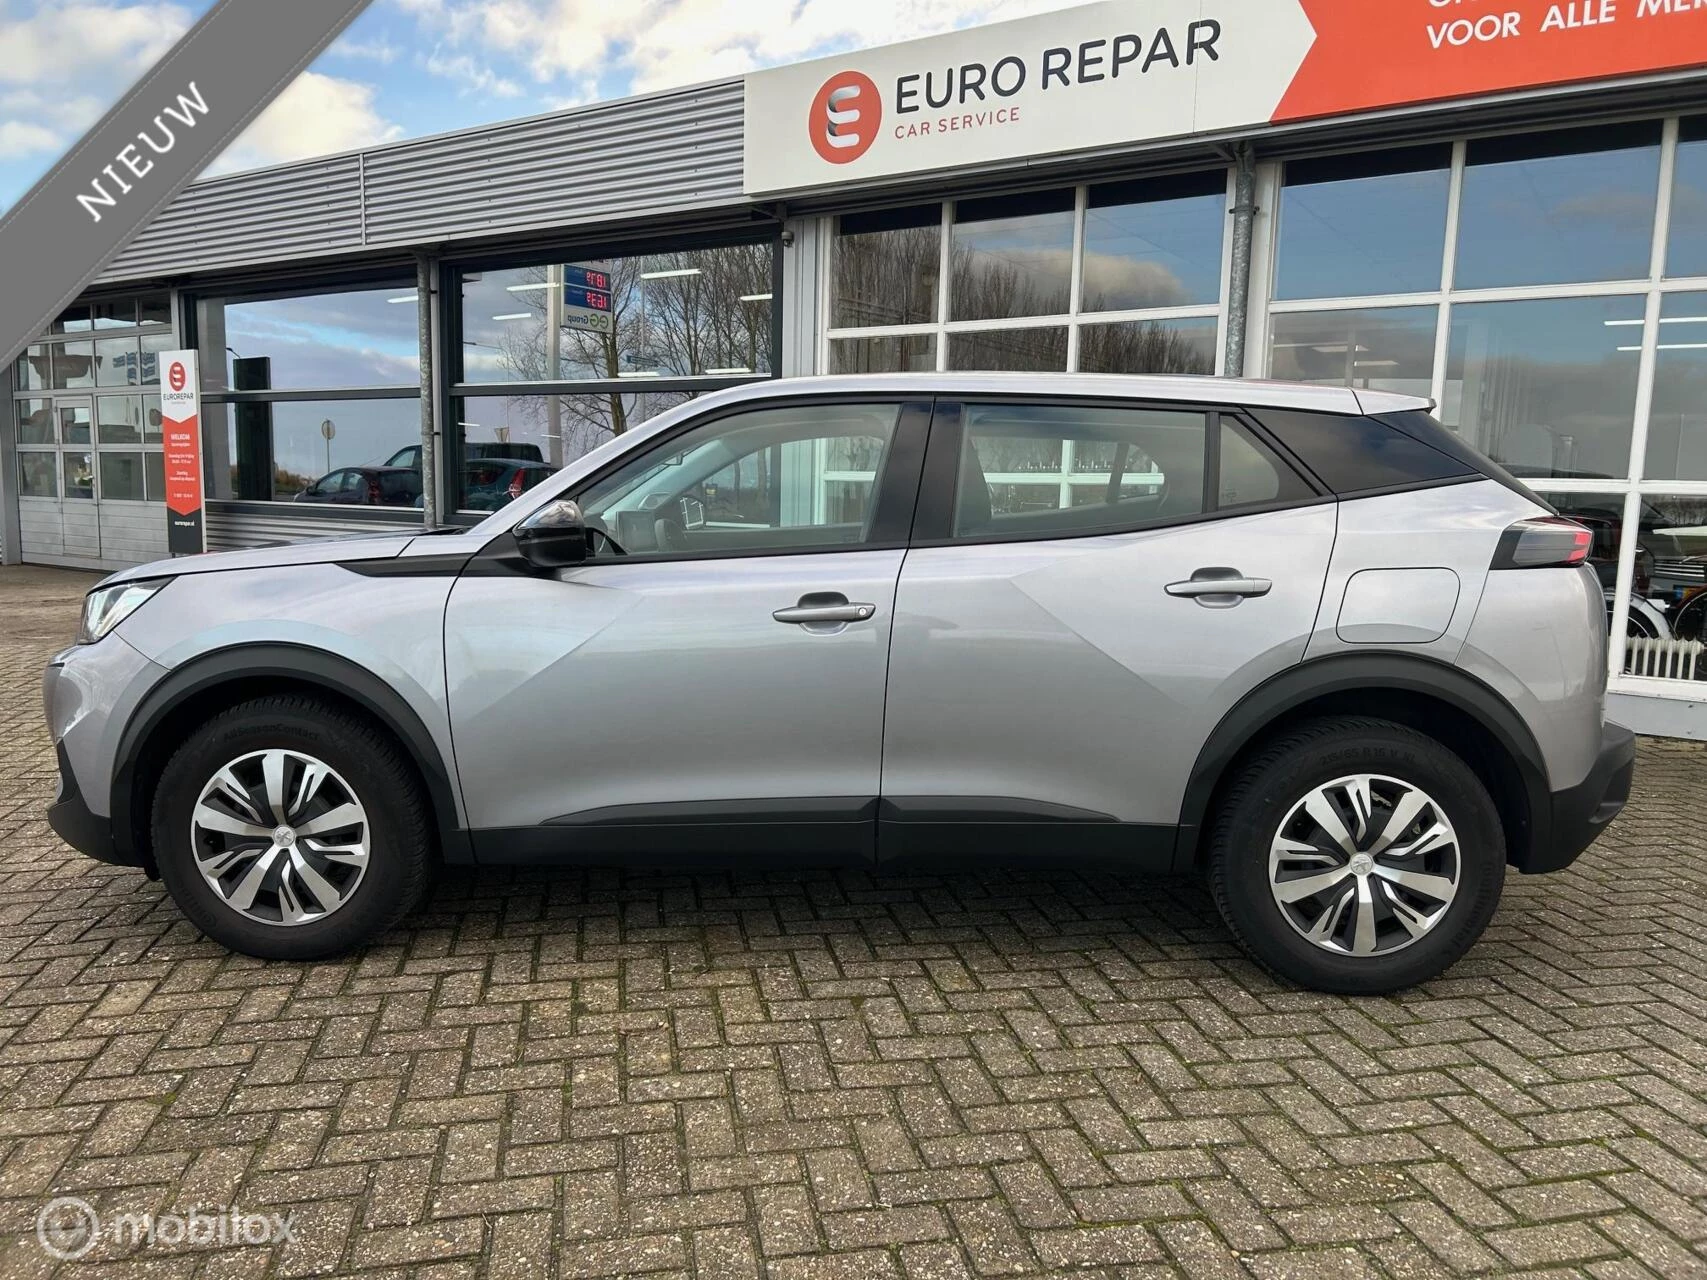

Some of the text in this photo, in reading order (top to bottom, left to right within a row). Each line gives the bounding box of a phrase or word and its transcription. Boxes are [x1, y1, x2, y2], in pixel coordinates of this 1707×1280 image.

[1426, 11, 1520, 49] VOOR
[1540, 0, 1616, 32] ALLE
[896, 19, 1220, 114] EURO REPAR
[895, 107, 1019, 139] CAR SERVICE
[163, 392, 194, 400] EUROREPAR
